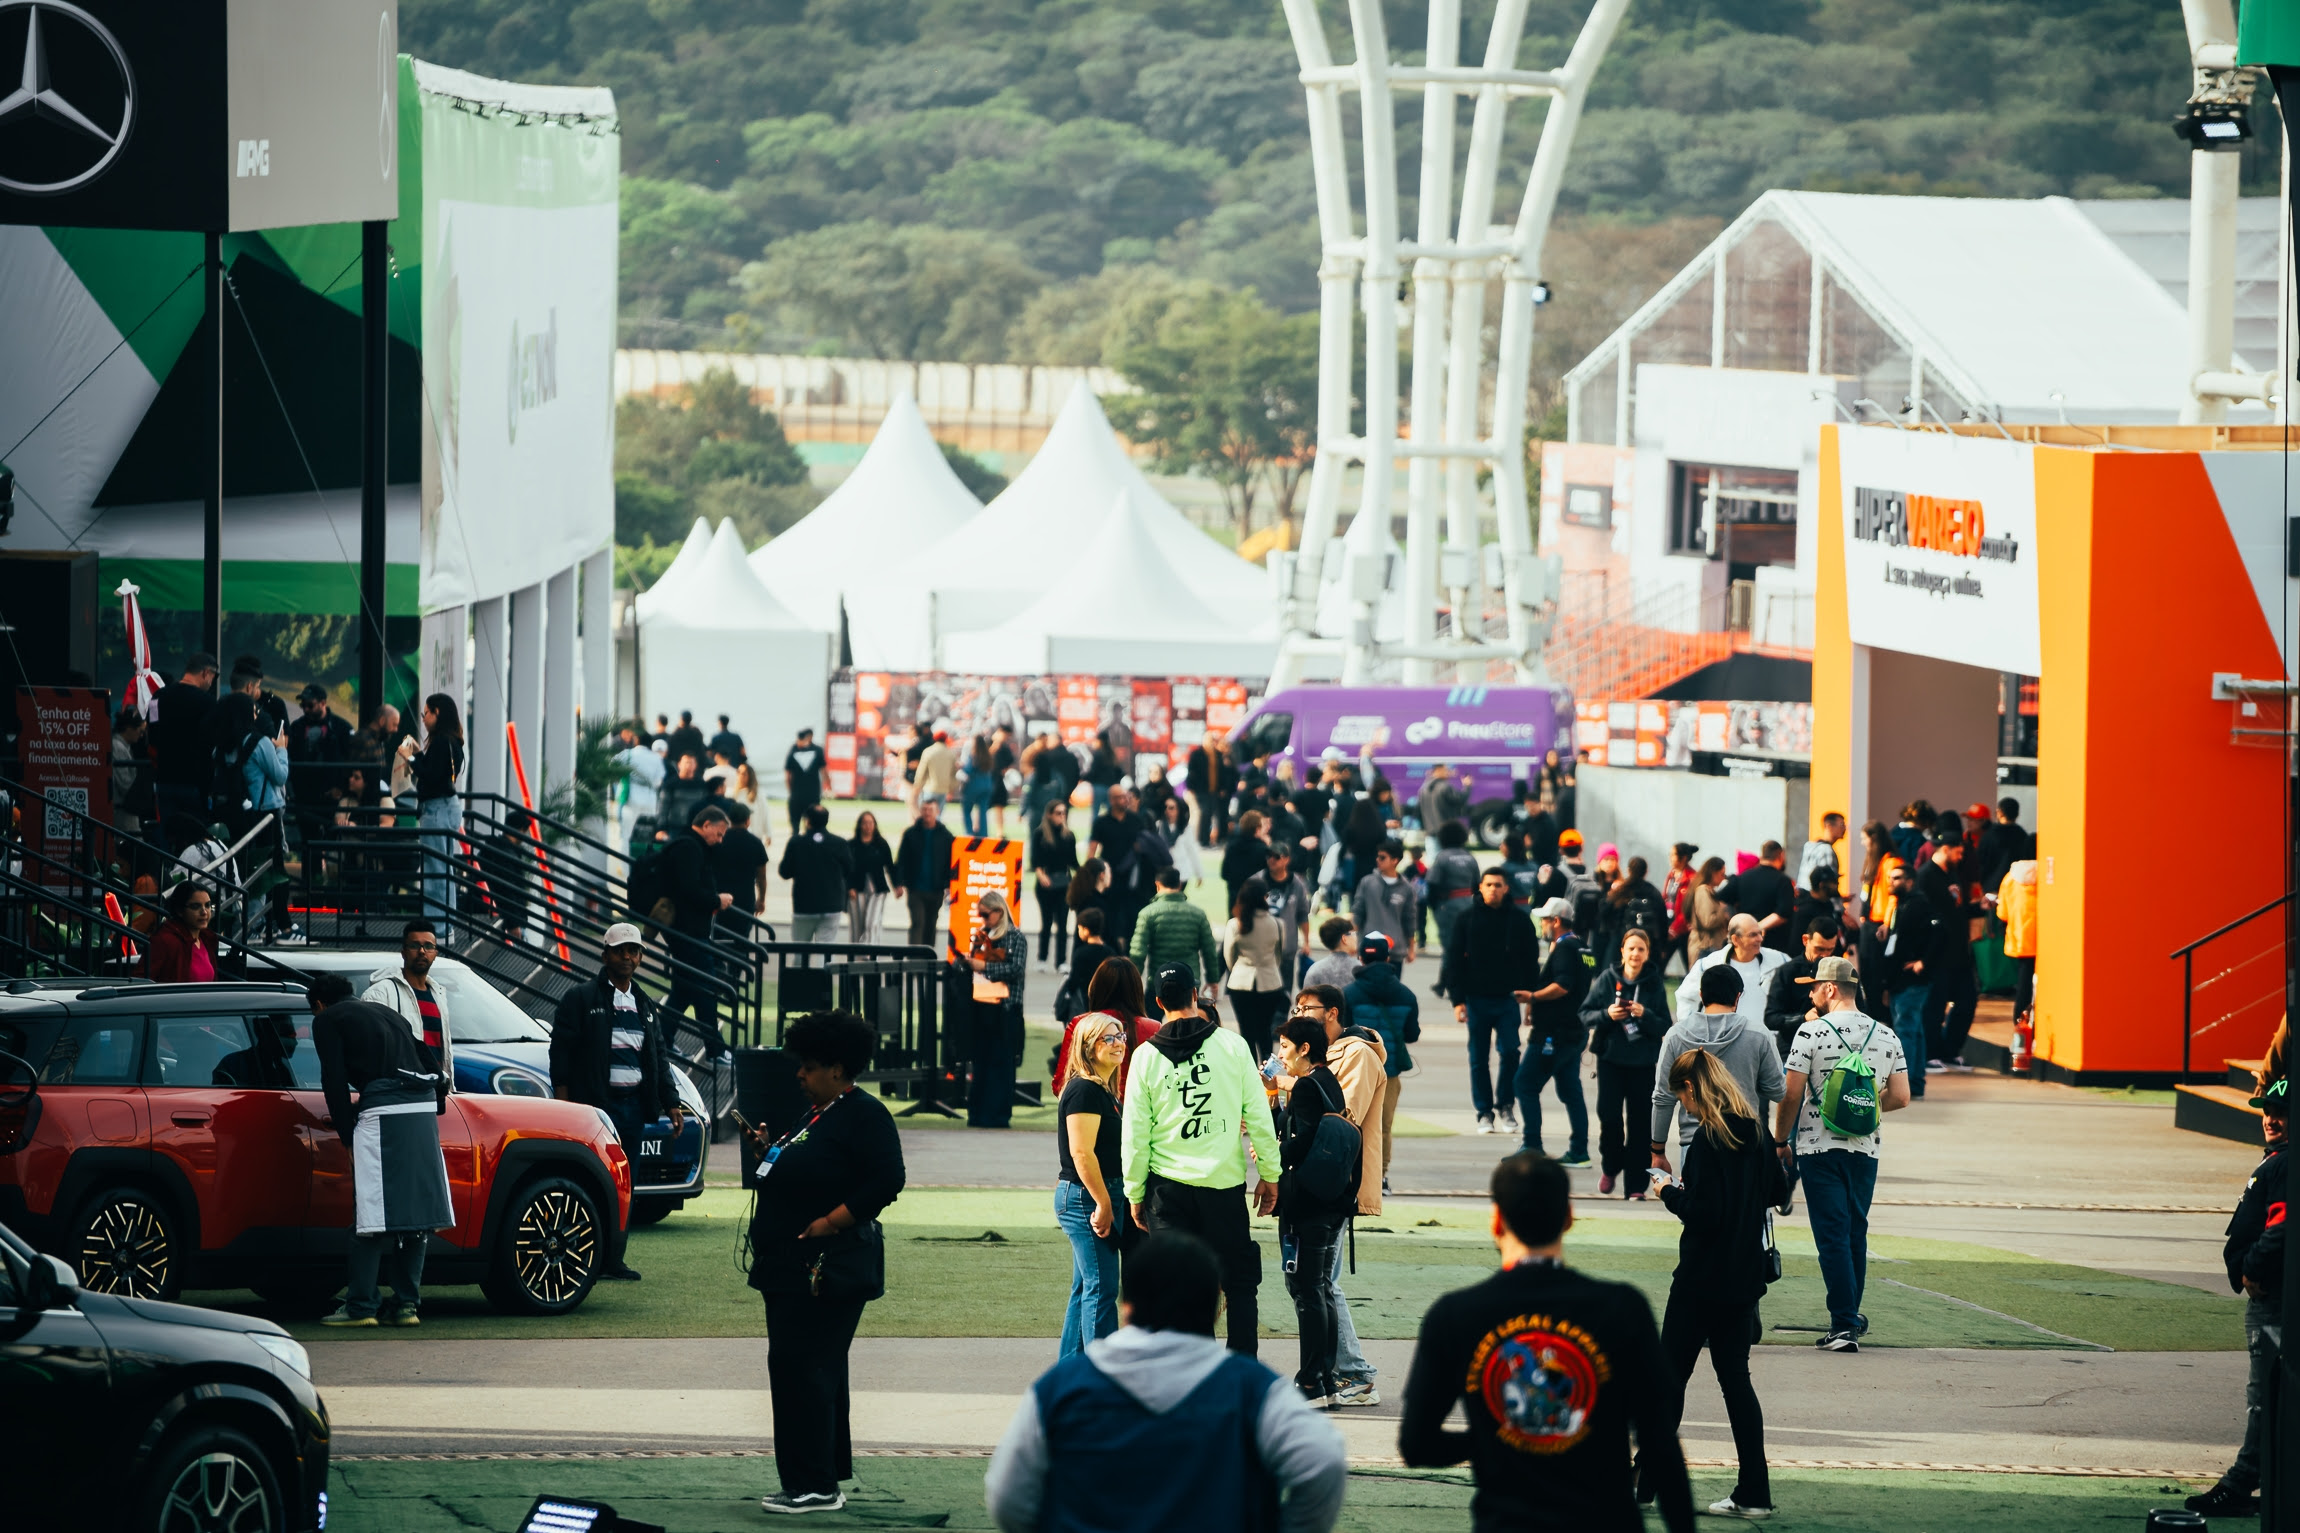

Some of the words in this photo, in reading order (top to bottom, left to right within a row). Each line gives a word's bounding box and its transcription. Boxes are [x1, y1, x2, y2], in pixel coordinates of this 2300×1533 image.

[239, 139, 270, 177] AMG
[36, 706, 70, 720] Tenha
[72, 708, 91, 721] até
[38, 721, 65, 735] 15%
[67, 722, 91, 736] OFF
[1447, 719, 1535, 739] PneuStore
[29, 739, 42, 749] na
[44, 740, 66, 750] taxa
[67, 739, 80, 750] do
[82, 742, 99, 751] seu
[28, 751, 101, 766] financiamento.
[38, 773, 60, 782] Acesse
[639, 1139, 663, 1156] INI
